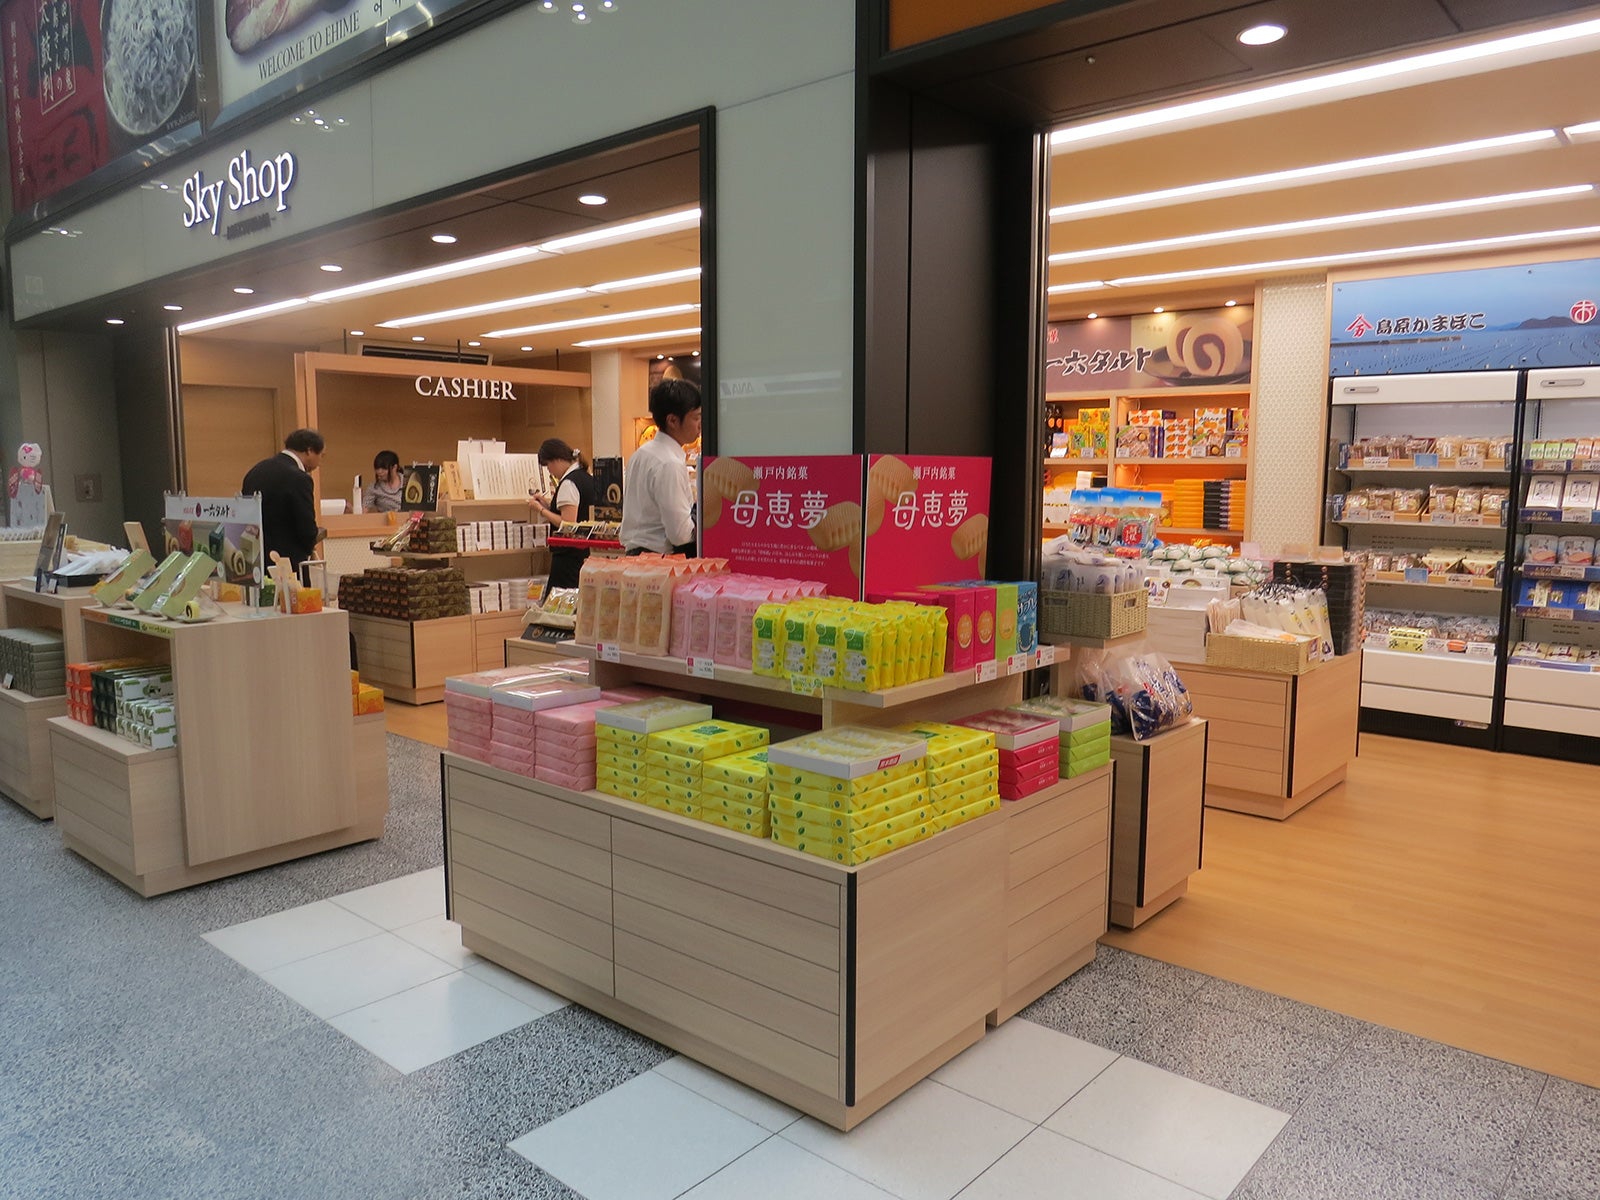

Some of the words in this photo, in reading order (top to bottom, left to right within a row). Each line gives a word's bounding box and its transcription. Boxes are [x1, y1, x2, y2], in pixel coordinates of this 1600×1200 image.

[258, 41, 305, 80] WELCOME
[307, 31, 323, 55] TO
[325, 10, 361, 45] EHIME
[183, 171, 224, 235] Sky
[228, 150, 294, 211] Shop
[1374, 312, 1487, 336] 島原かまぼこ
[1046, 347, 1152, 376] 一六タルト
[414, 375, 517, 401] CASHIER
[752, 465, 809, 481] 瀬戸内銘菓
[912, 465, 957, 481] 瀬戸内銘菓
[730, 489, 829, 528] 母恵夢
[892, 489, 969, 530] 母恵夢
